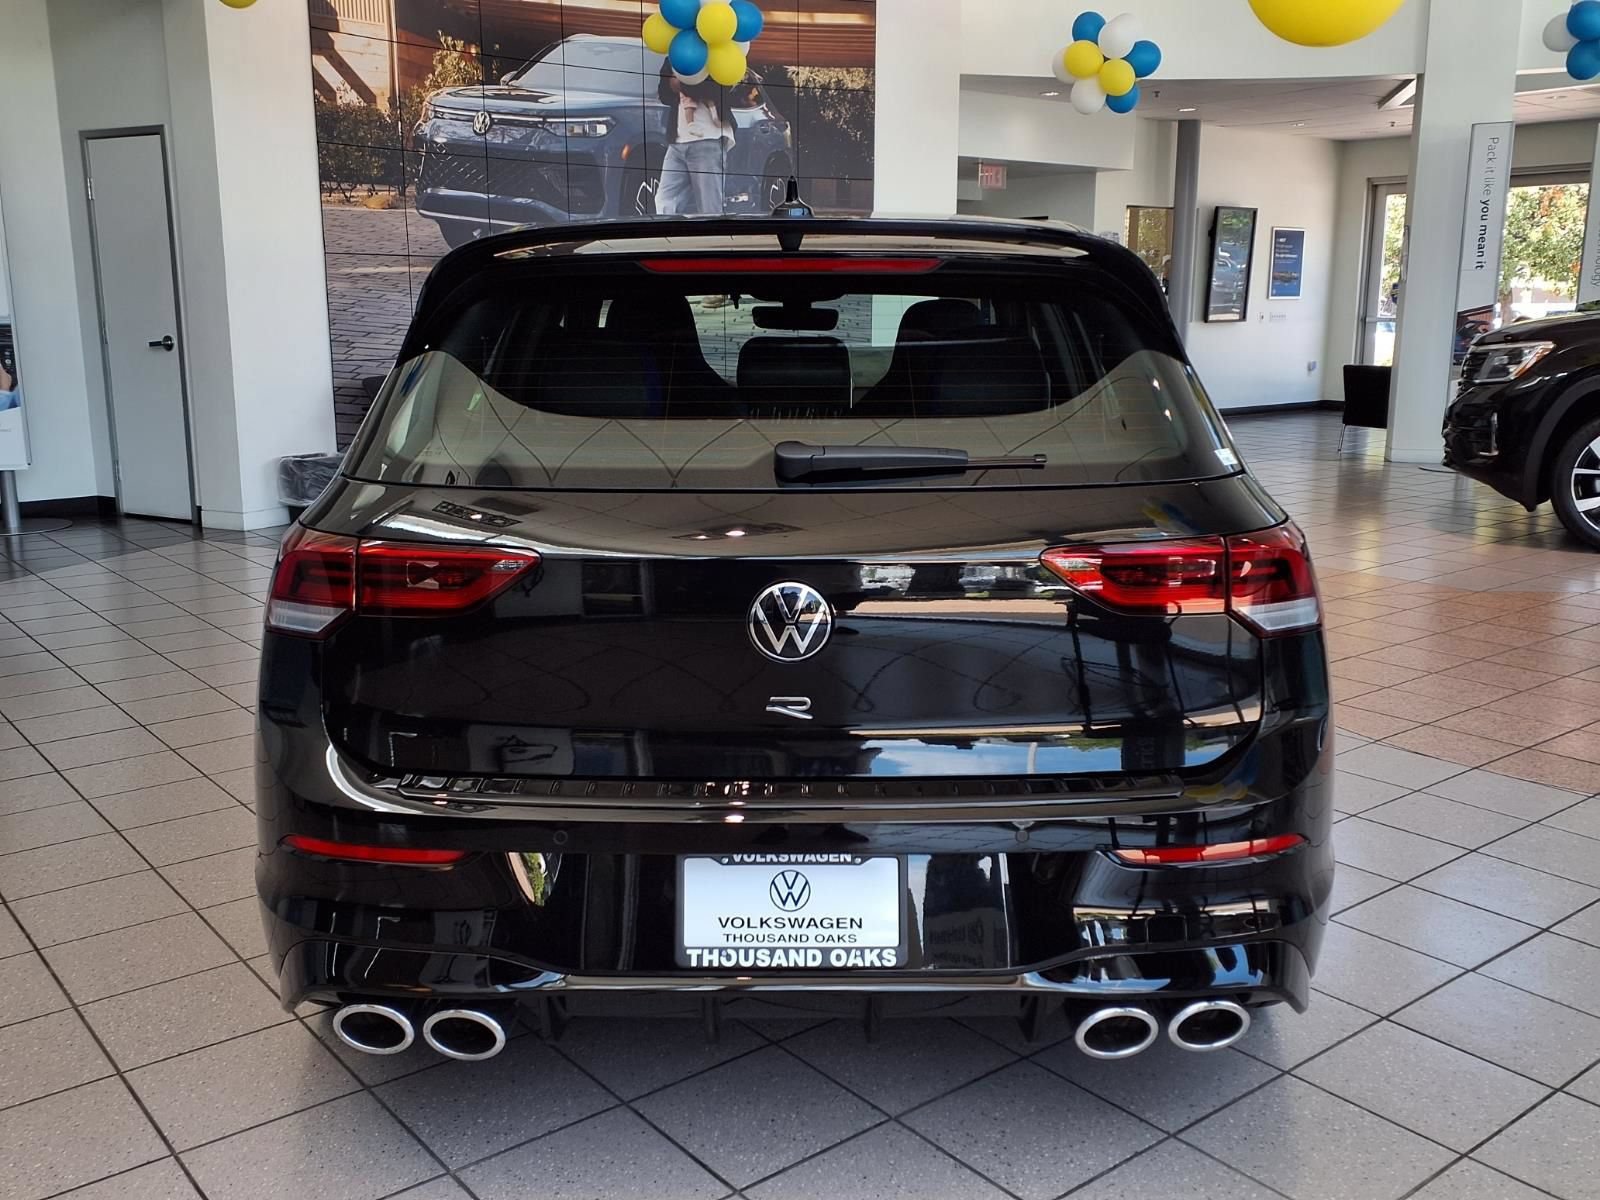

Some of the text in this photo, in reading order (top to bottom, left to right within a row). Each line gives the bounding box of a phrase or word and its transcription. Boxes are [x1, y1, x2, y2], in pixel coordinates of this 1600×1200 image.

[1475, 136, 1500, 270] Pack it like you mean it
[765, 696, 814, 720] R
[717, 916, 863, 929] VOLKSWAGEN
[723, 933, 858, 943] THOUSAND OAKS
[686, 948, 897, 967] THOUSAND OAKS
